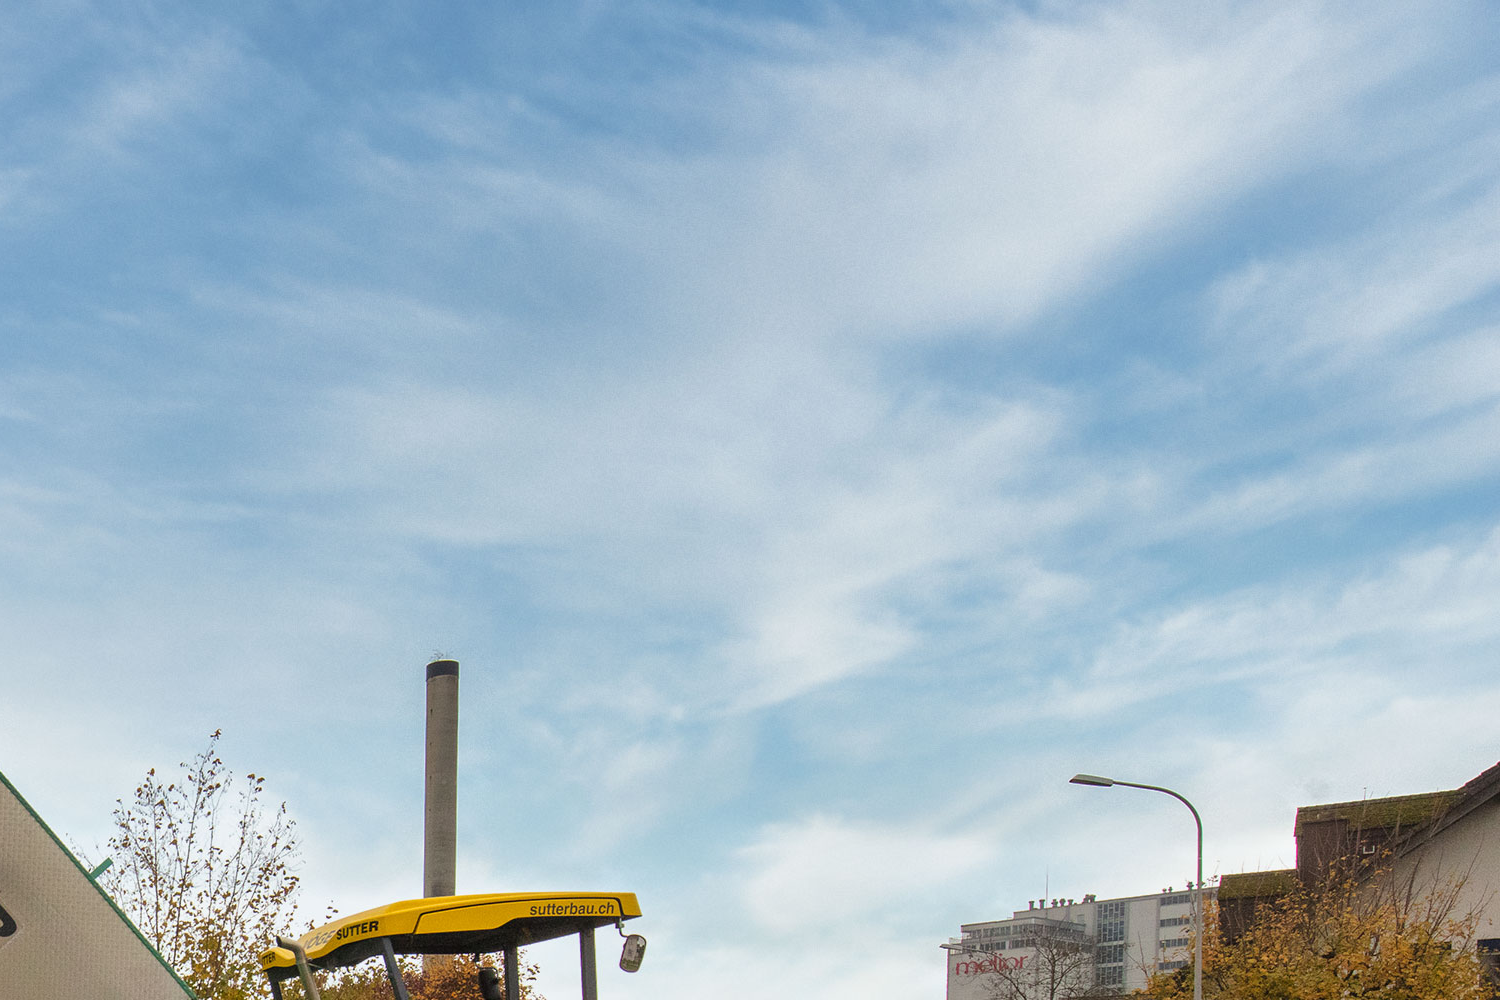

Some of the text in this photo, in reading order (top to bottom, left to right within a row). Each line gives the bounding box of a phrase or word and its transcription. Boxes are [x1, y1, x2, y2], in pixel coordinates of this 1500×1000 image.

[529, 902, 615, 915] sutterbau.ch
[336, 920, 379, 940] SUTTER
[956, 953, 1029, 975] melior
